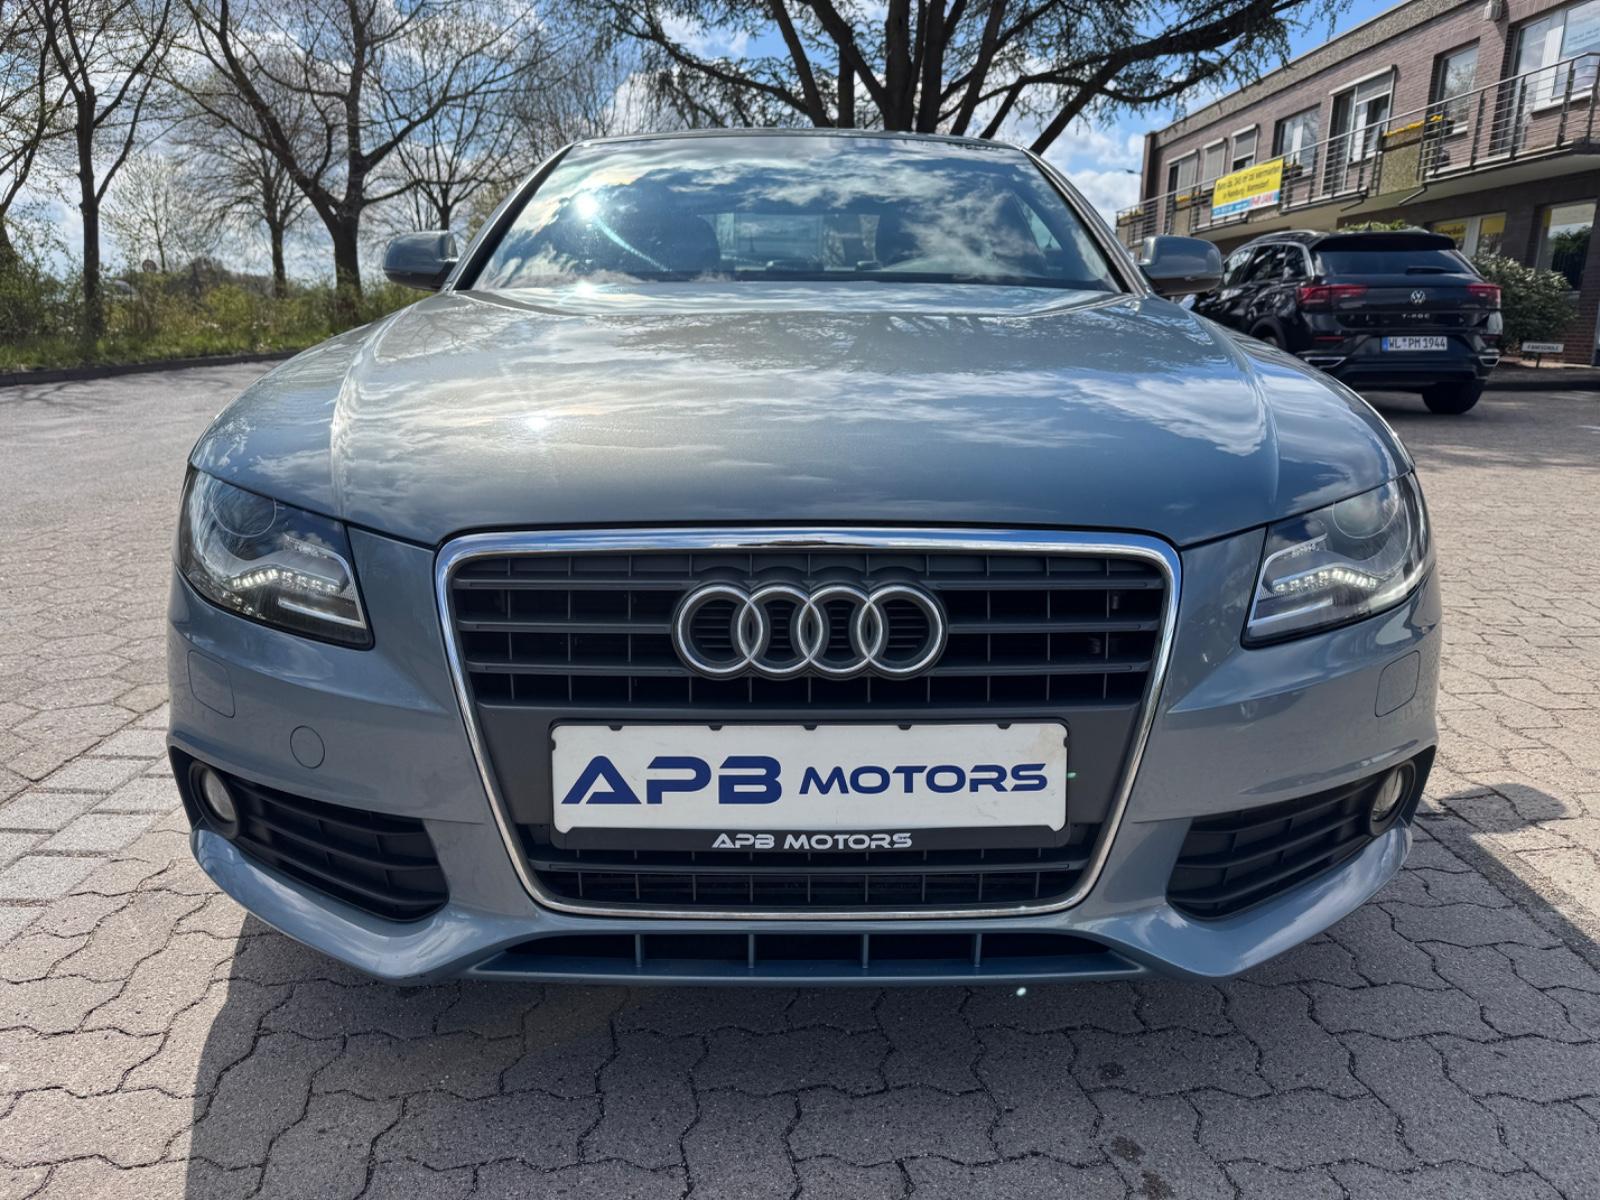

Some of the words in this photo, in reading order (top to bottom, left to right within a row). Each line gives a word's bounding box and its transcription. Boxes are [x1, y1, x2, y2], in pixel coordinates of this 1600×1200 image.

[1423, 337, 1446, 349] 1944
[561, 755, 783, 805] APB
[798, 763, 1048, 795] MOTORS
[711, 832, 775, 850] APB
[783, 832, 913, 850] MOTORS
